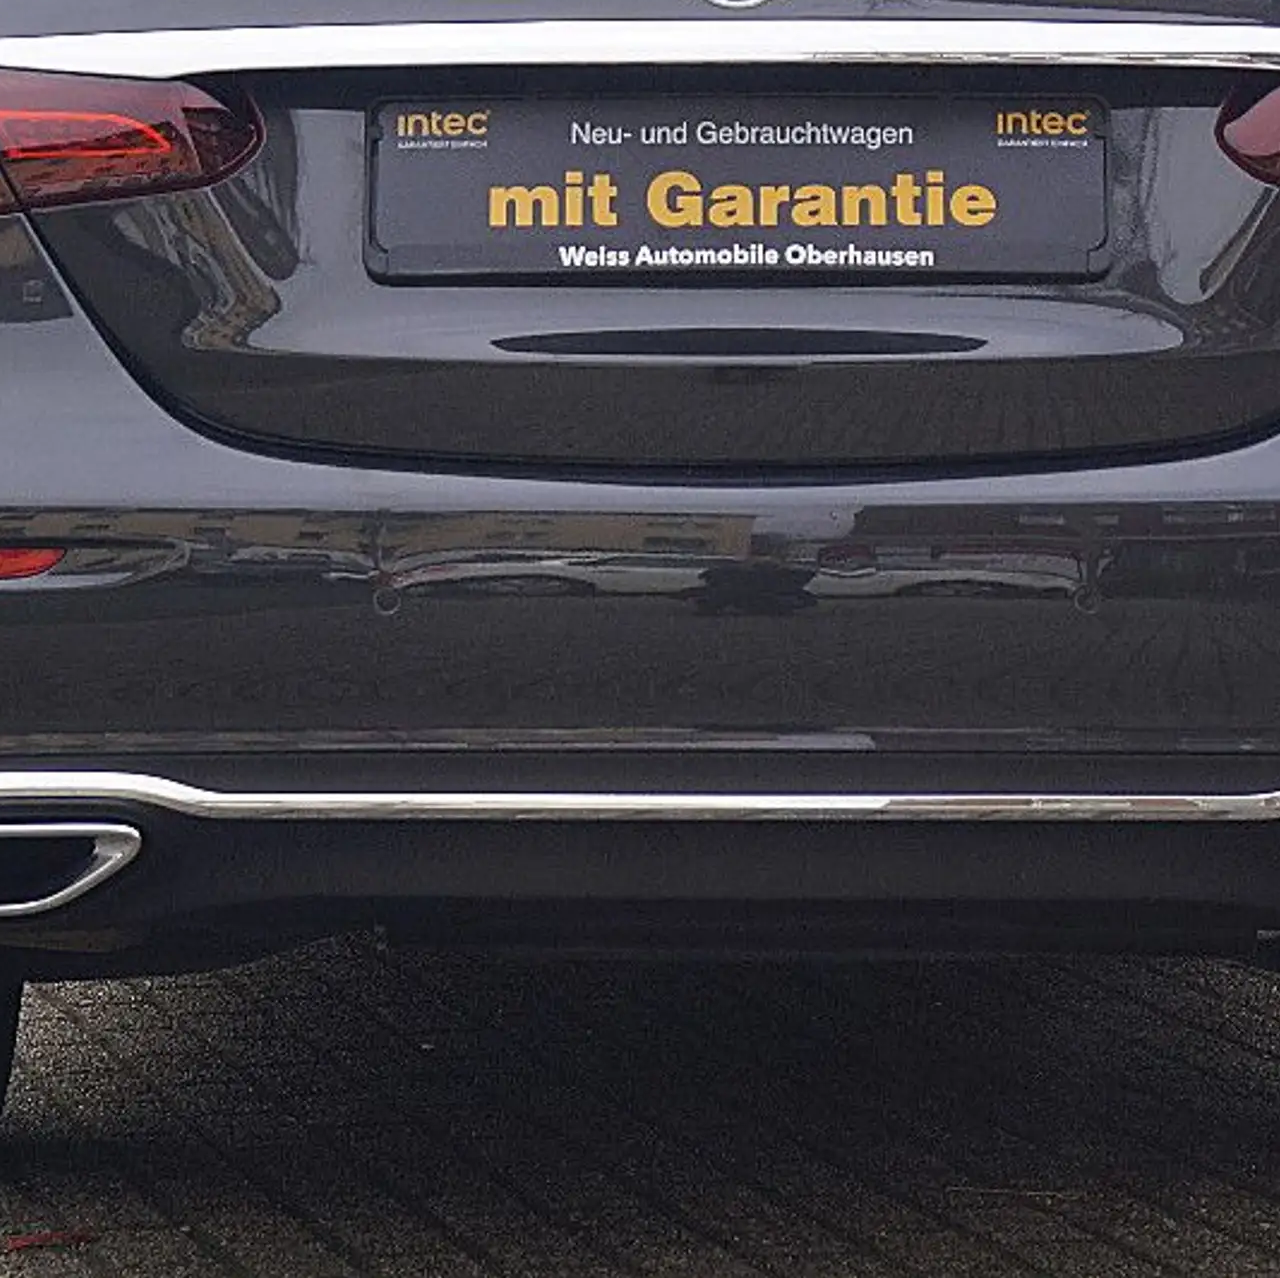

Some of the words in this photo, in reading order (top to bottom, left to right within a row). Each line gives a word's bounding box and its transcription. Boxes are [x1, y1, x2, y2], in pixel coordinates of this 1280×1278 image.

[396, 109, 491, 138] intec
[570, 120, 632, 145] Neu-
[641, 121, 688, 145] und
[696, 120, 914, 150] Gebrauchtwagen
[996, 108, 1091, 135] intec
[488, 170, 617, 227] mit
[646, 169, 997, 227] Garantie
[558, 246, 629, 267] Weiss
[634, 244, 779, 266] Automobile
[784, 244, 935, 267] Oberhausen
